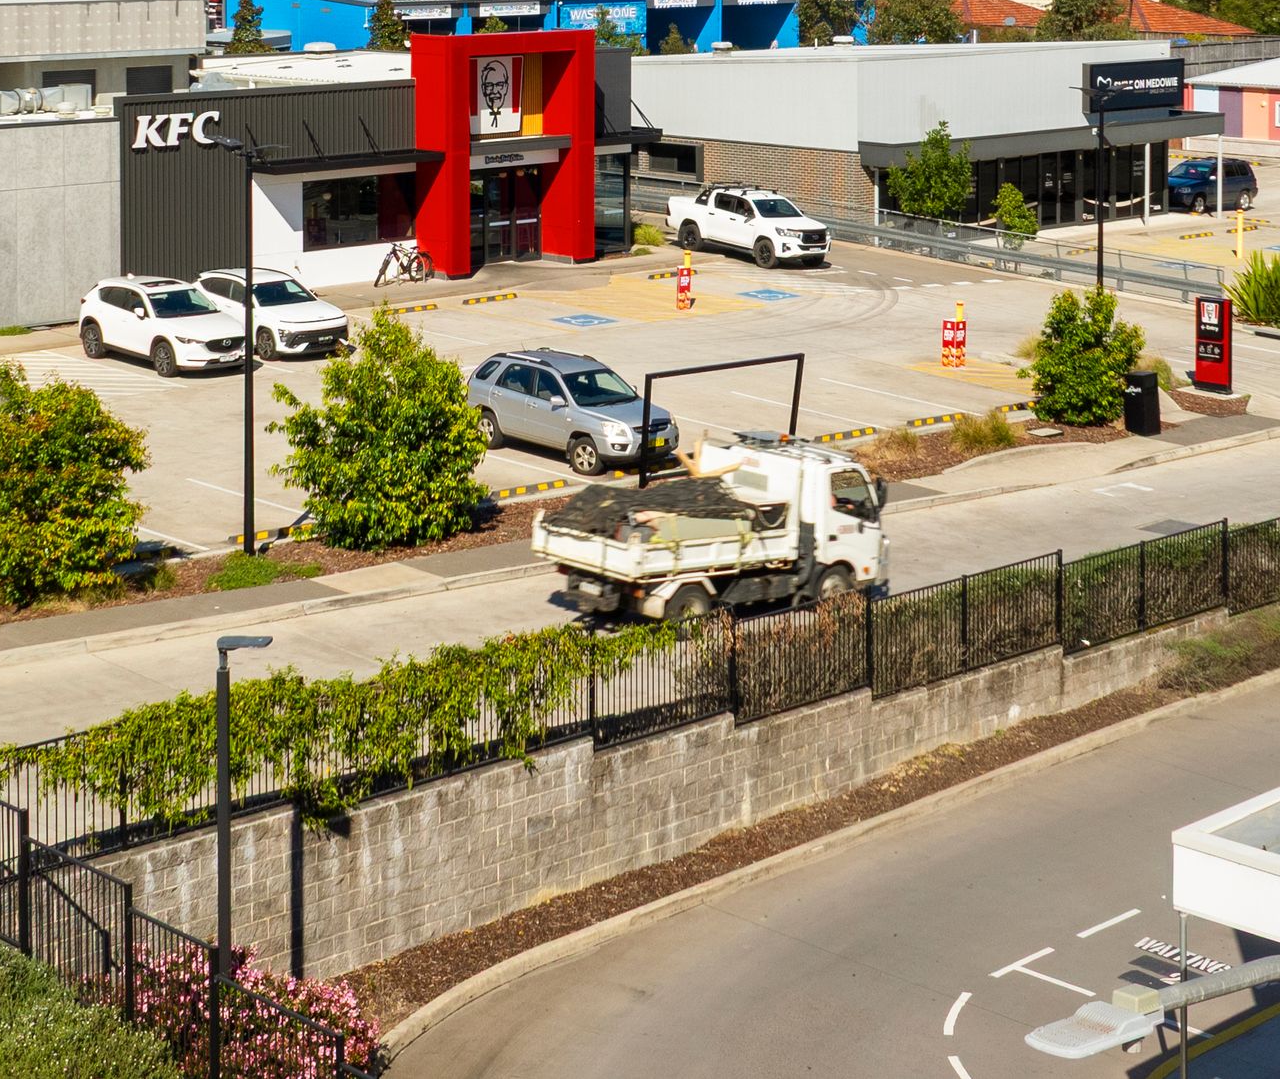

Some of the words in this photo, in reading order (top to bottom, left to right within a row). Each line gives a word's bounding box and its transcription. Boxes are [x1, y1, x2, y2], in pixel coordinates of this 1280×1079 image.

[1134, 79, 1145, 89] ON
[1146, 77, 1178, 88] MEDOWIE
[132, 111, 220, 148] KFC
